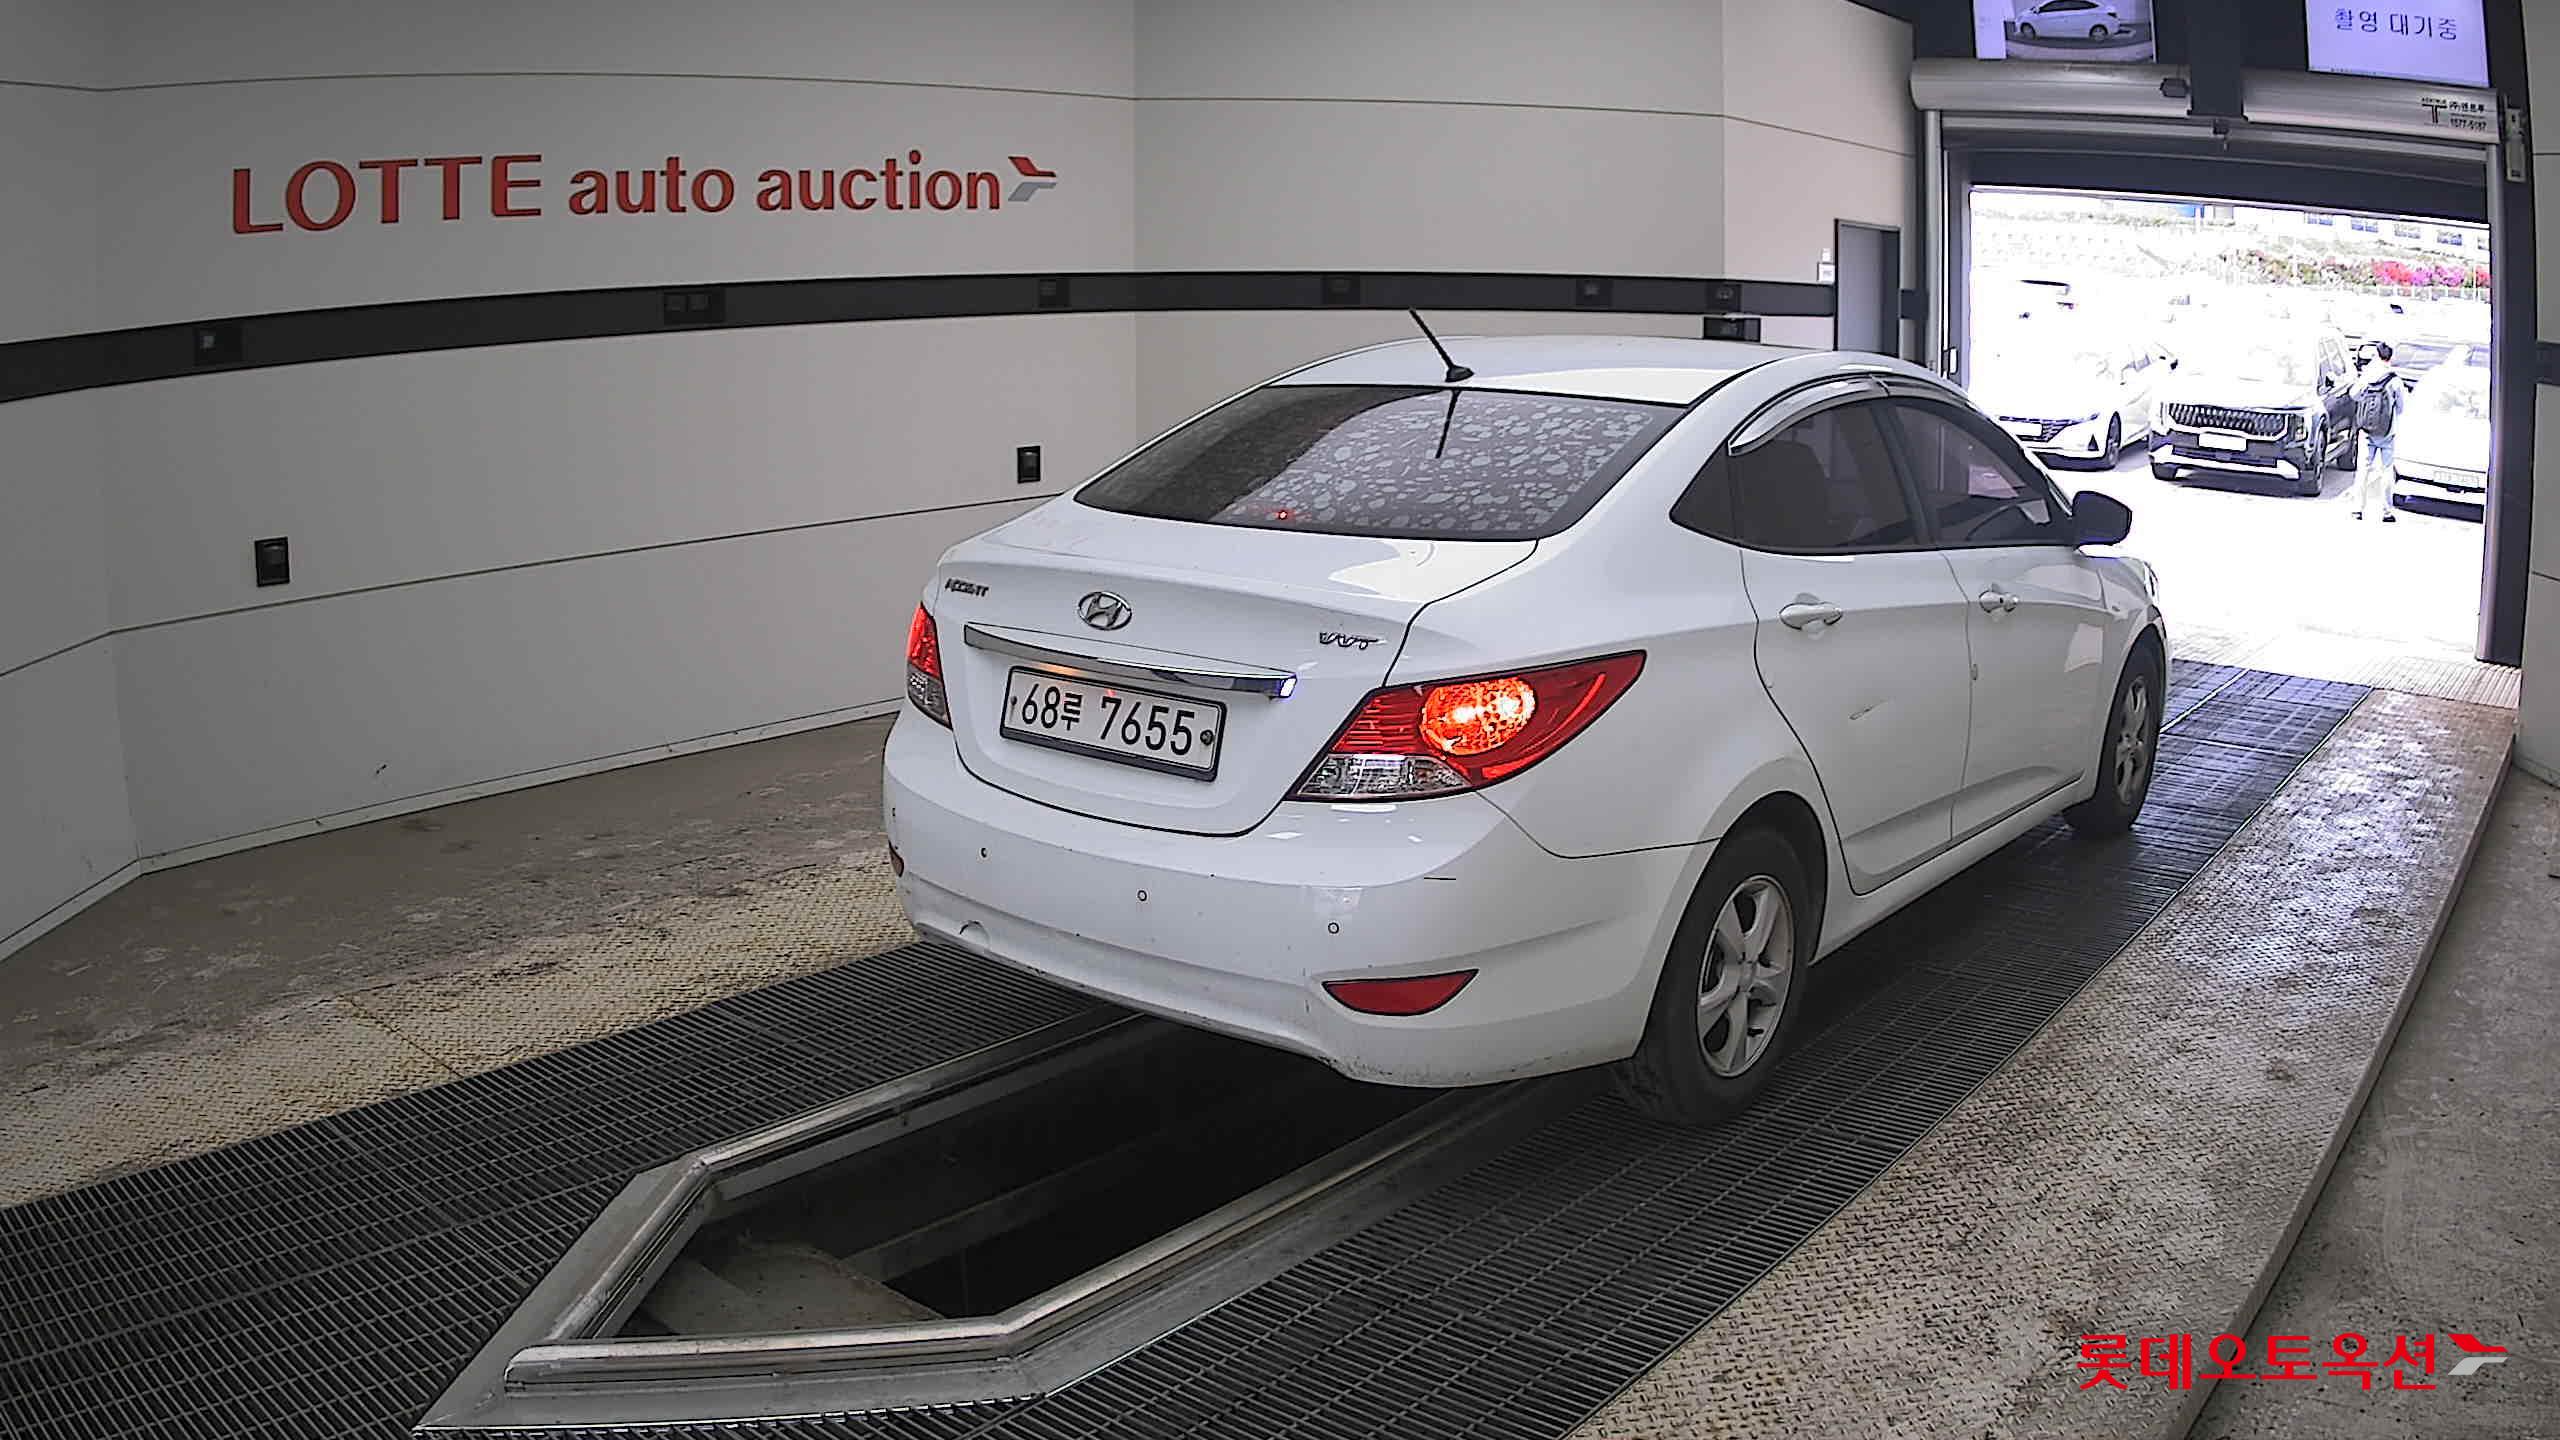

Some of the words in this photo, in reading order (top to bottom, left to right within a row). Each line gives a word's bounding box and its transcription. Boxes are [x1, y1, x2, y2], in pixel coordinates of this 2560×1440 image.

[2335, 8, 2378, 33] 촬영
[232, 155, 542, 234] LOTTE
[568, 156, 735, 215] auto
[756, 151, 1002, 211] auction
[1021, 683, 1083, 731] 68루
[1099, 695, 1196, 756] 7655
